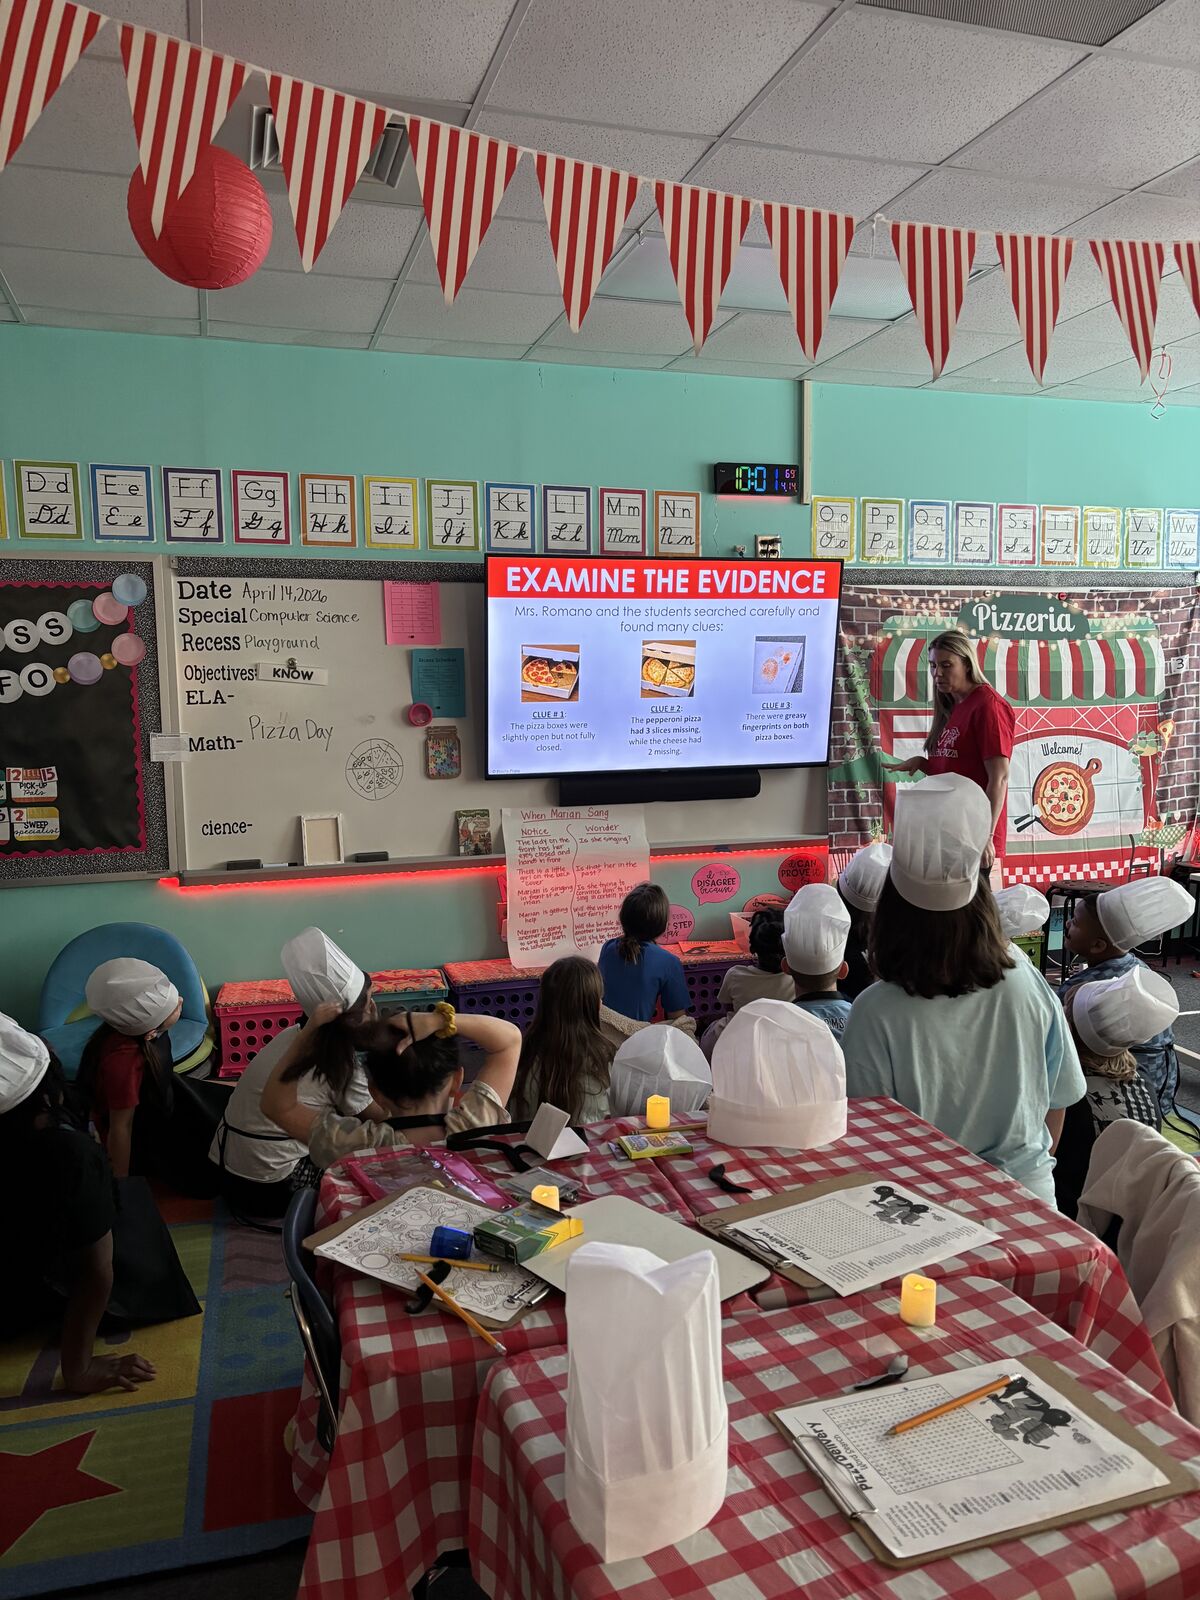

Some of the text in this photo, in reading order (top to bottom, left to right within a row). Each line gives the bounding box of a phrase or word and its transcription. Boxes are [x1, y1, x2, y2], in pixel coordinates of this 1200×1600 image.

[735, 466, 779, 492] 10:01
[506, 567, 826, 594] EXAMINE THE EVIDENCE
[177, 580, 232, 600] Date
[242, 582, 276, 603] April
[178, 608, 360, 625] Special Computer Science
[514, 605, 819, 620] Mrs. Romano and the students searched carefully and
[972, 603, 1075, 633] Pizzeria
[620, 620, 724, 635] found many clues:
[181, 634, 320, 653] Recess Playground
[1176, 658, 1185, 670] 3
[272, 667, 314, 681] KNOW
[186, 690, 235, 705] ELA-
[532, 711, 551, 719] CLUE
[650, 705, 669, 713] CLUE
[645, 717, 683, 726] pepperoni
[684, 716, 701, 724] pizza
[785, 714, 807, 722] greasy
[249, 714, 333, 752] Pizza Day
[527, 723, 545, 731] pizza
[742, 723, 782, 732] fingerprints
[502, 733, 528, 743] slightly
[579, 732, 596, 741] fully
[755, 733, 772, 742] pizza
[189, 736, 243, 752] Math-
[1041, 743, 1083, 757] Welcome!
[6, 769, 22, 781] 12
[42, 768, 56, 781] 15
[13, 809, 24, 822] 2
[520, 807, 609, 820] When Marian Sang
[24, 821, 49, 829] SWEEP
[201, 820, 253, 836] cience-
[585, 823, 620, 832] Wonder
[521, 828, 549, 836] Notice
[797, 860, 817, 868] CAN
[781, 869, 810, 878] PROVE
[696, 877, 736, 888] DISAGREE
[700, 884, 735, 895] because
[673, 920, 693, 930] STEP
